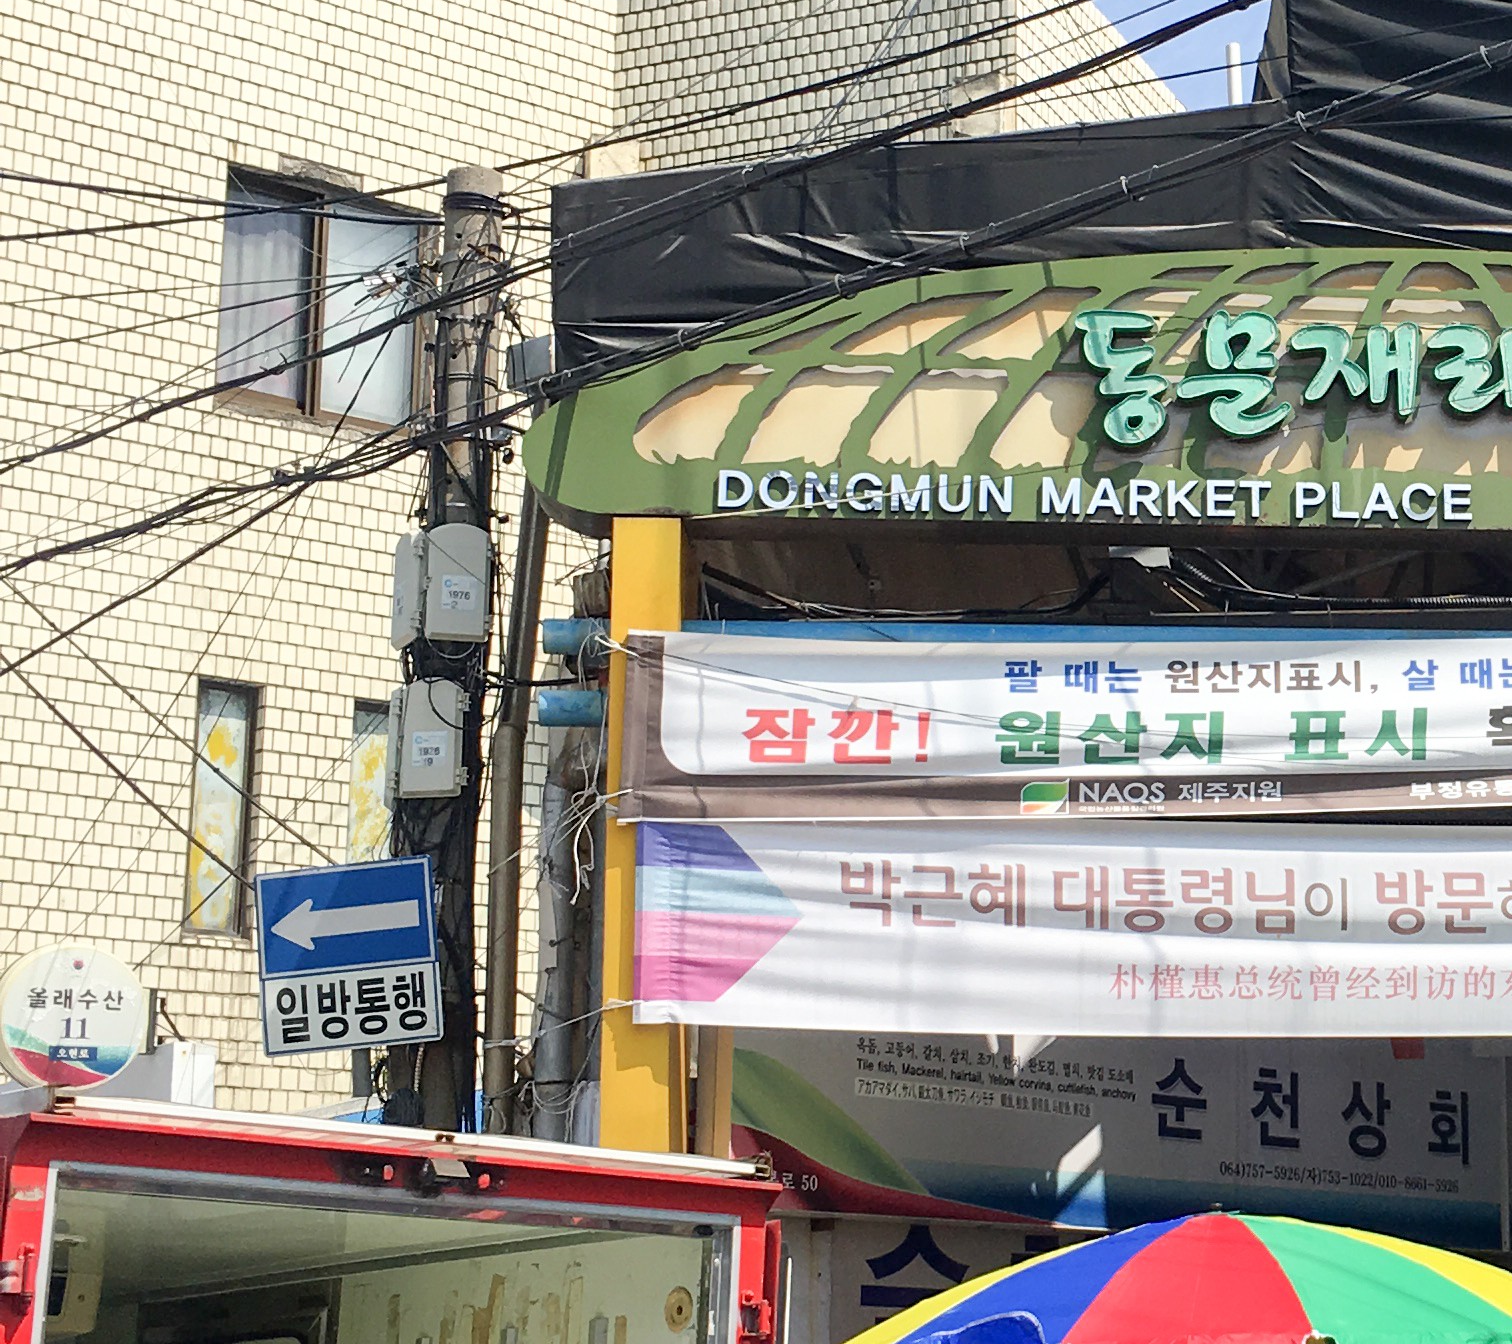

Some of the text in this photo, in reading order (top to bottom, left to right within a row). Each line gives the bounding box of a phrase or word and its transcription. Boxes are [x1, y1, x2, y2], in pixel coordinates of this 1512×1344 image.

[716, 469, 1473, 523] DONGMUN MARKET PLACE
[1004, 659, 1043, 694] 팔
[1064, 659, 1142, 694] 때는
[1164, 659, 1380, 694] 원산지표시,
[1404, 658, 1440, 691] 살
[742, 707, 931, 764] 잠깐!
[995, 709, 1224, 766] 원산지
[1284, 706, 1428, 763] 표시
[1078, 781, 1166, 805] NAQS
[1178, 781, 1283, 803] 제주지원
[840, 859, 1027, 930] 박근혜
[1052, 866, 1348, 934] 대통령님이
[27, 987, 124, 1011] 올래수산
[275, 971, 430, 1044] 일방통행
[60, 1017, 90, 1040] 11
[801, 1174, 819, 1192] 50
